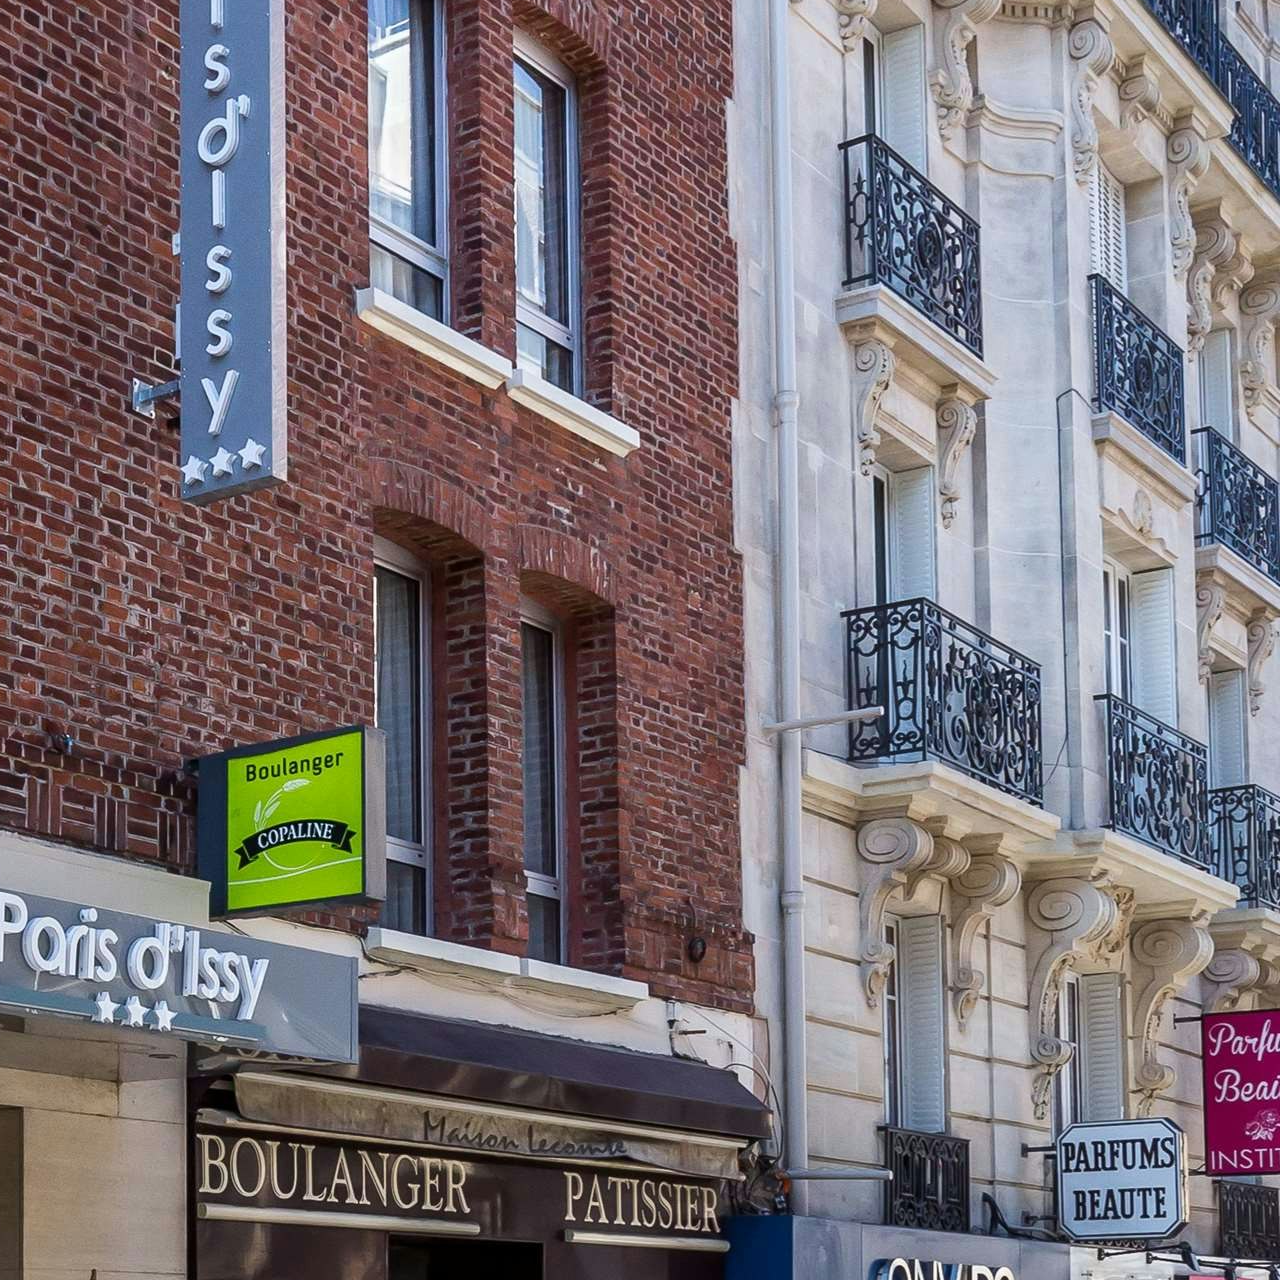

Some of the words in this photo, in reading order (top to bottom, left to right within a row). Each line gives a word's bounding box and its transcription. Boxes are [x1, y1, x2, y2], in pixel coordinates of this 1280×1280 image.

[245, 752, 344, 782] Boulanger
[257, 822, 334, 849] COPALINE
[127, 922, 270, 1021] d'Issy
[423, 1111, 519, 1150] Maison
[1062, 1136, 1175, 1173] PARFUMS
[196, 1133, 471, 1214] BOULANGER
[563, 1171, 720, 1233] PATISSIER
[1073, 1187, 1167, 1221] BEAUTE
